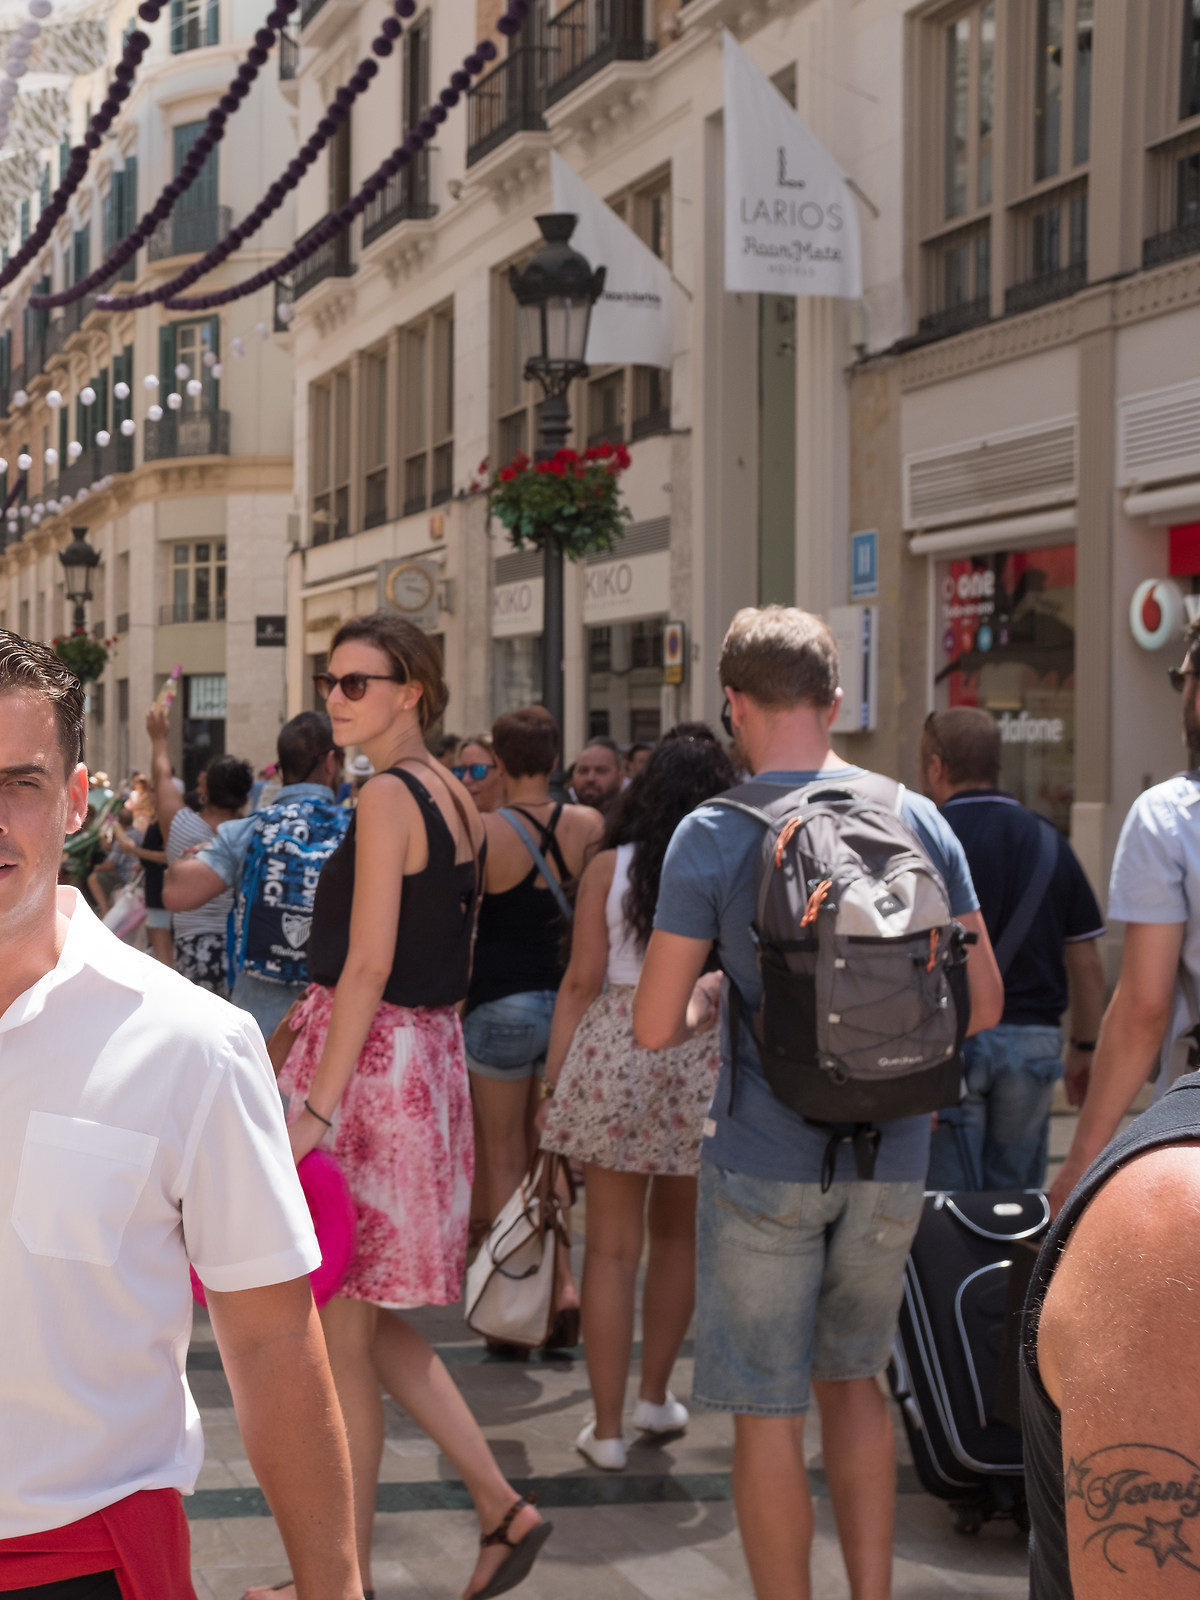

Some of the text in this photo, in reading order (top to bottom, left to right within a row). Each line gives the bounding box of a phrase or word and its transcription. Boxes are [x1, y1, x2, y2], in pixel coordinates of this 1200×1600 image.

[777, 145, 805, 188] L
[739, 197, 844, 232] LARIOS
[586, 562, 633, 599] KIKO
[494, 583, 532, 616] KIKO
